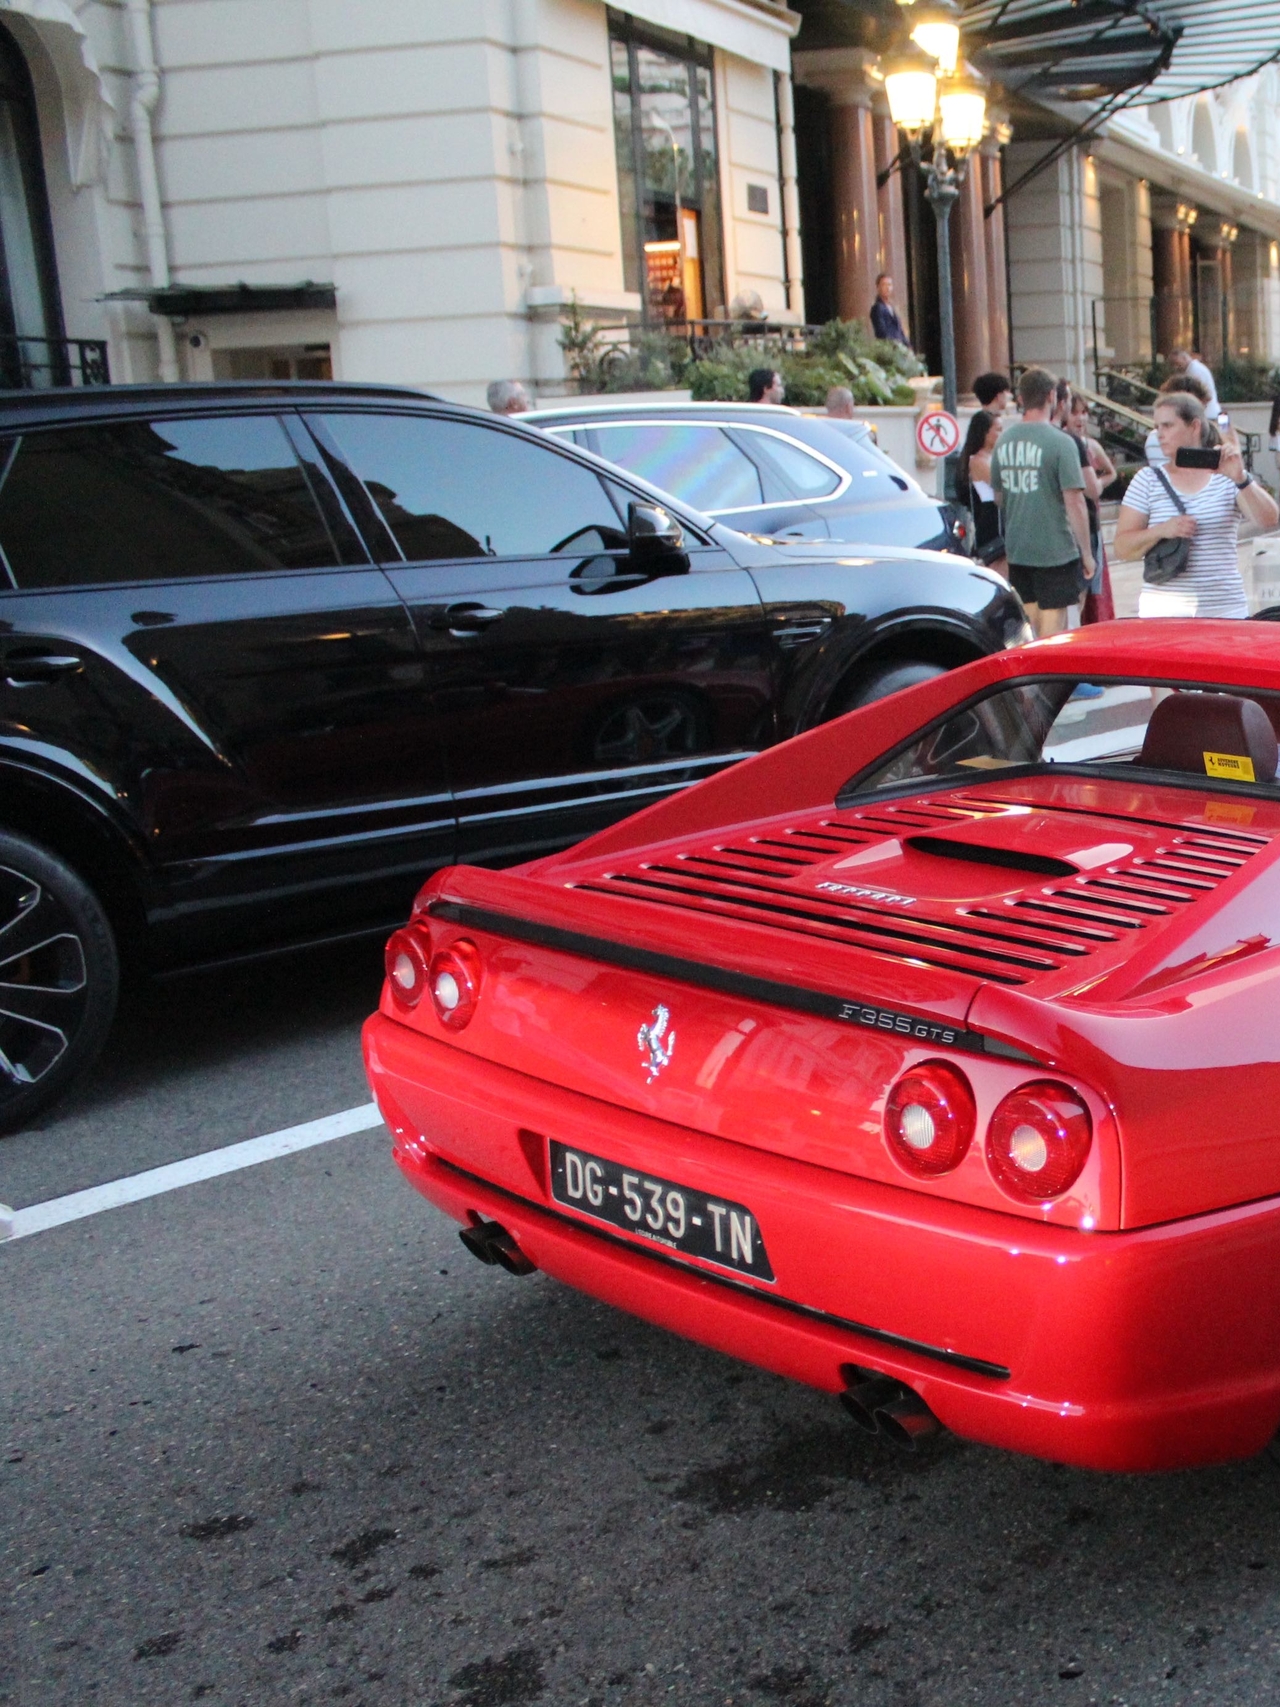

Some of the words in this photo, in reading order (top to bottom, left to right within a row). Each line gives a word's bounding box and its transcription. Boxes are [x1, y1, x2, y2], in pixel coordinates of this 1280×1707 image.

[997, 441, 1042, 468] MIAMI
[1000, 469, 1039, 494] SLICE
[838, 1004, 912, 1033] F355
[915, 1025, 955, 1043] GTS
[565, 1152, 753, 1264] DG-539-TN
